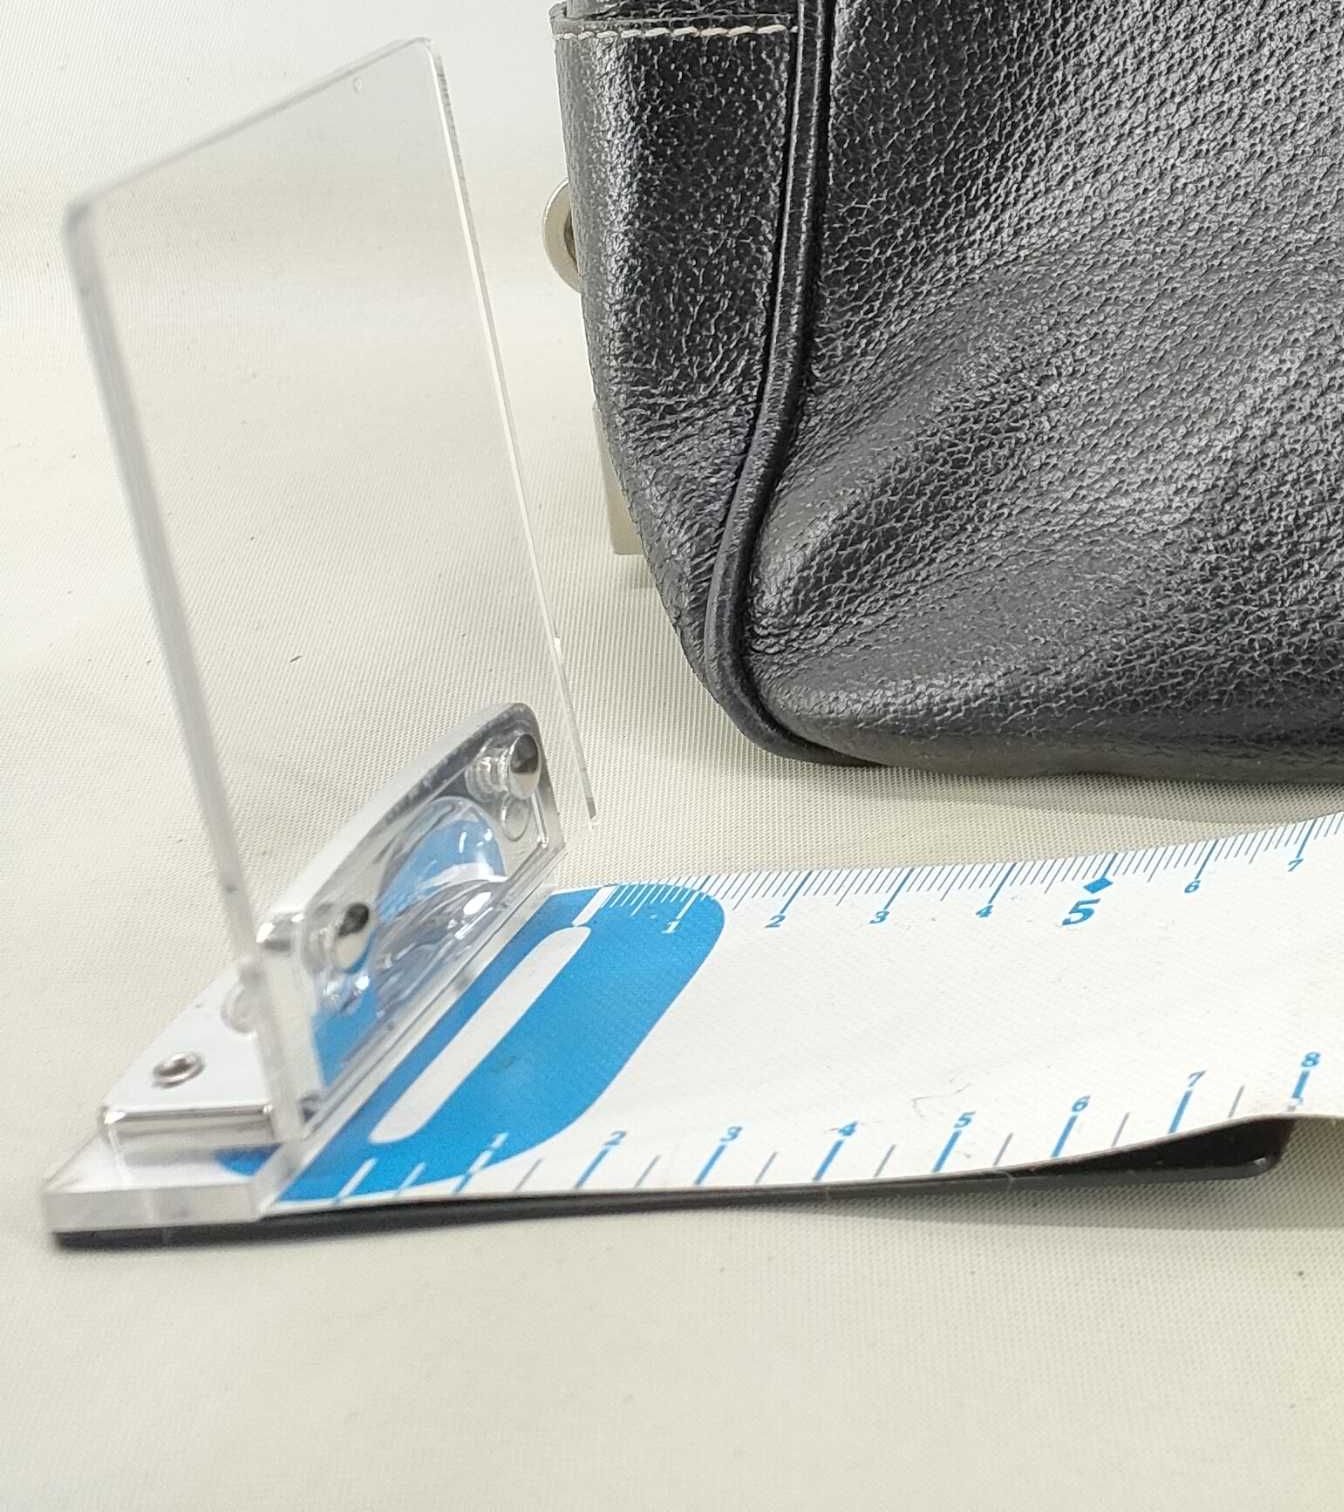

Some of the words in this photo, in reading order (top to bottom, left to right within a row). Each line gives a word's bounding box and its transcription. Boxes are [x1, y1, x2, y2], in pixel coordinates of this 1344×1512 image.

[661, 920, 681, 934] 1
[764, 914, 786, 928] 2
[869, 911, 890, 925] 3
[975, 903, 993, 919] 4
[1062, 900, 1101, 927] 5
[1183, 880, 1201, 894] 6
[1288, 858, 1304, 872] 7
[268, 881, 725, 1204] 0
[605, 1130, 627, 1146] 2
[720, 1126, 742, 1142] 3
[838, 1121, 858, 1138] 4
[954, 1110, 975, 1129] 5
[1071, 1096, 1091, 1113] 6
[1187, 1071, 1206, 1088] 7
[1301, 1053, 1320, 1068] 8
